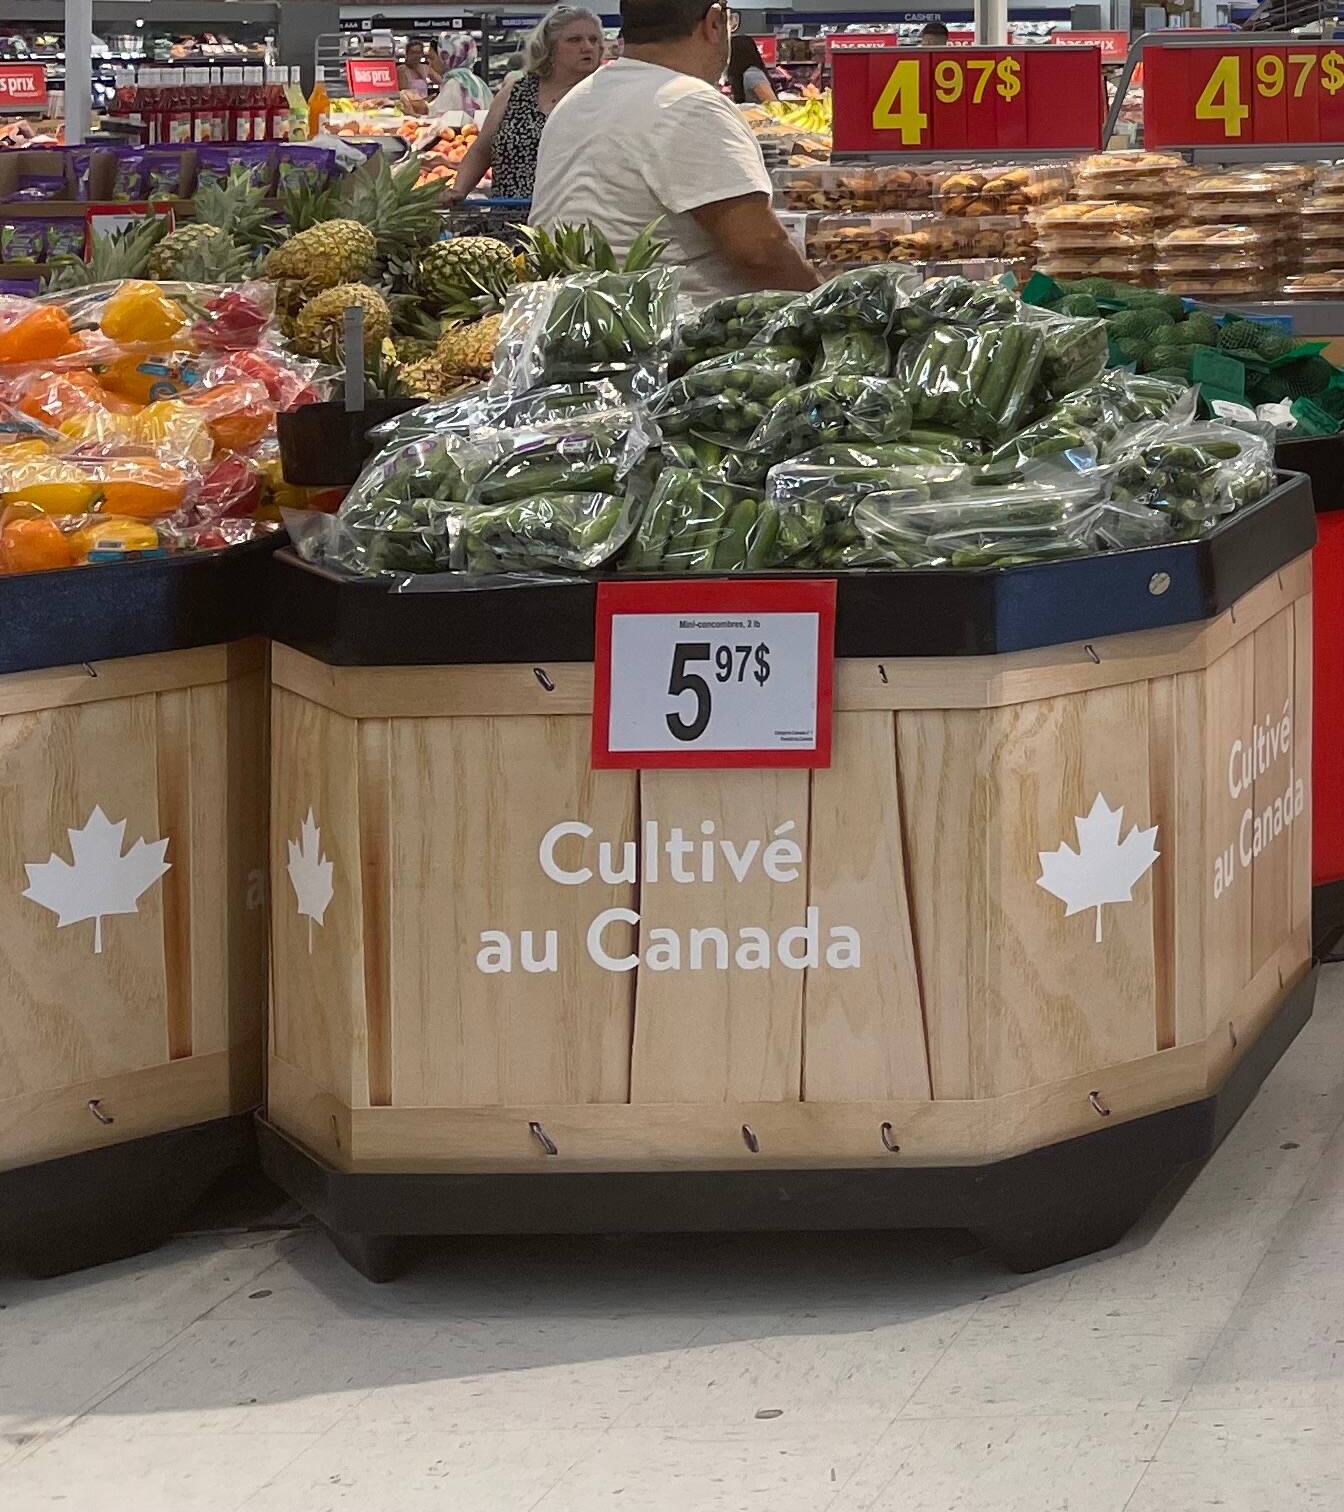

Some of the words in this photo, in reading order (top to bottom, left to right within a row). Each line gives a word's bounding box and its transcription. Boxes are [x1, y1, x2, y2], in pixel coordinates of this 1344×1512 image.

[1228, 699, 1291, 799] Cultivé
[539, 819, 802, 886] Cultivé
[1213, 843, 1234, 899] au
[1239, 767, 1304, 868] Canada
[476, 928, 559, 974] au
[586, 906, 862, 973] Canada
